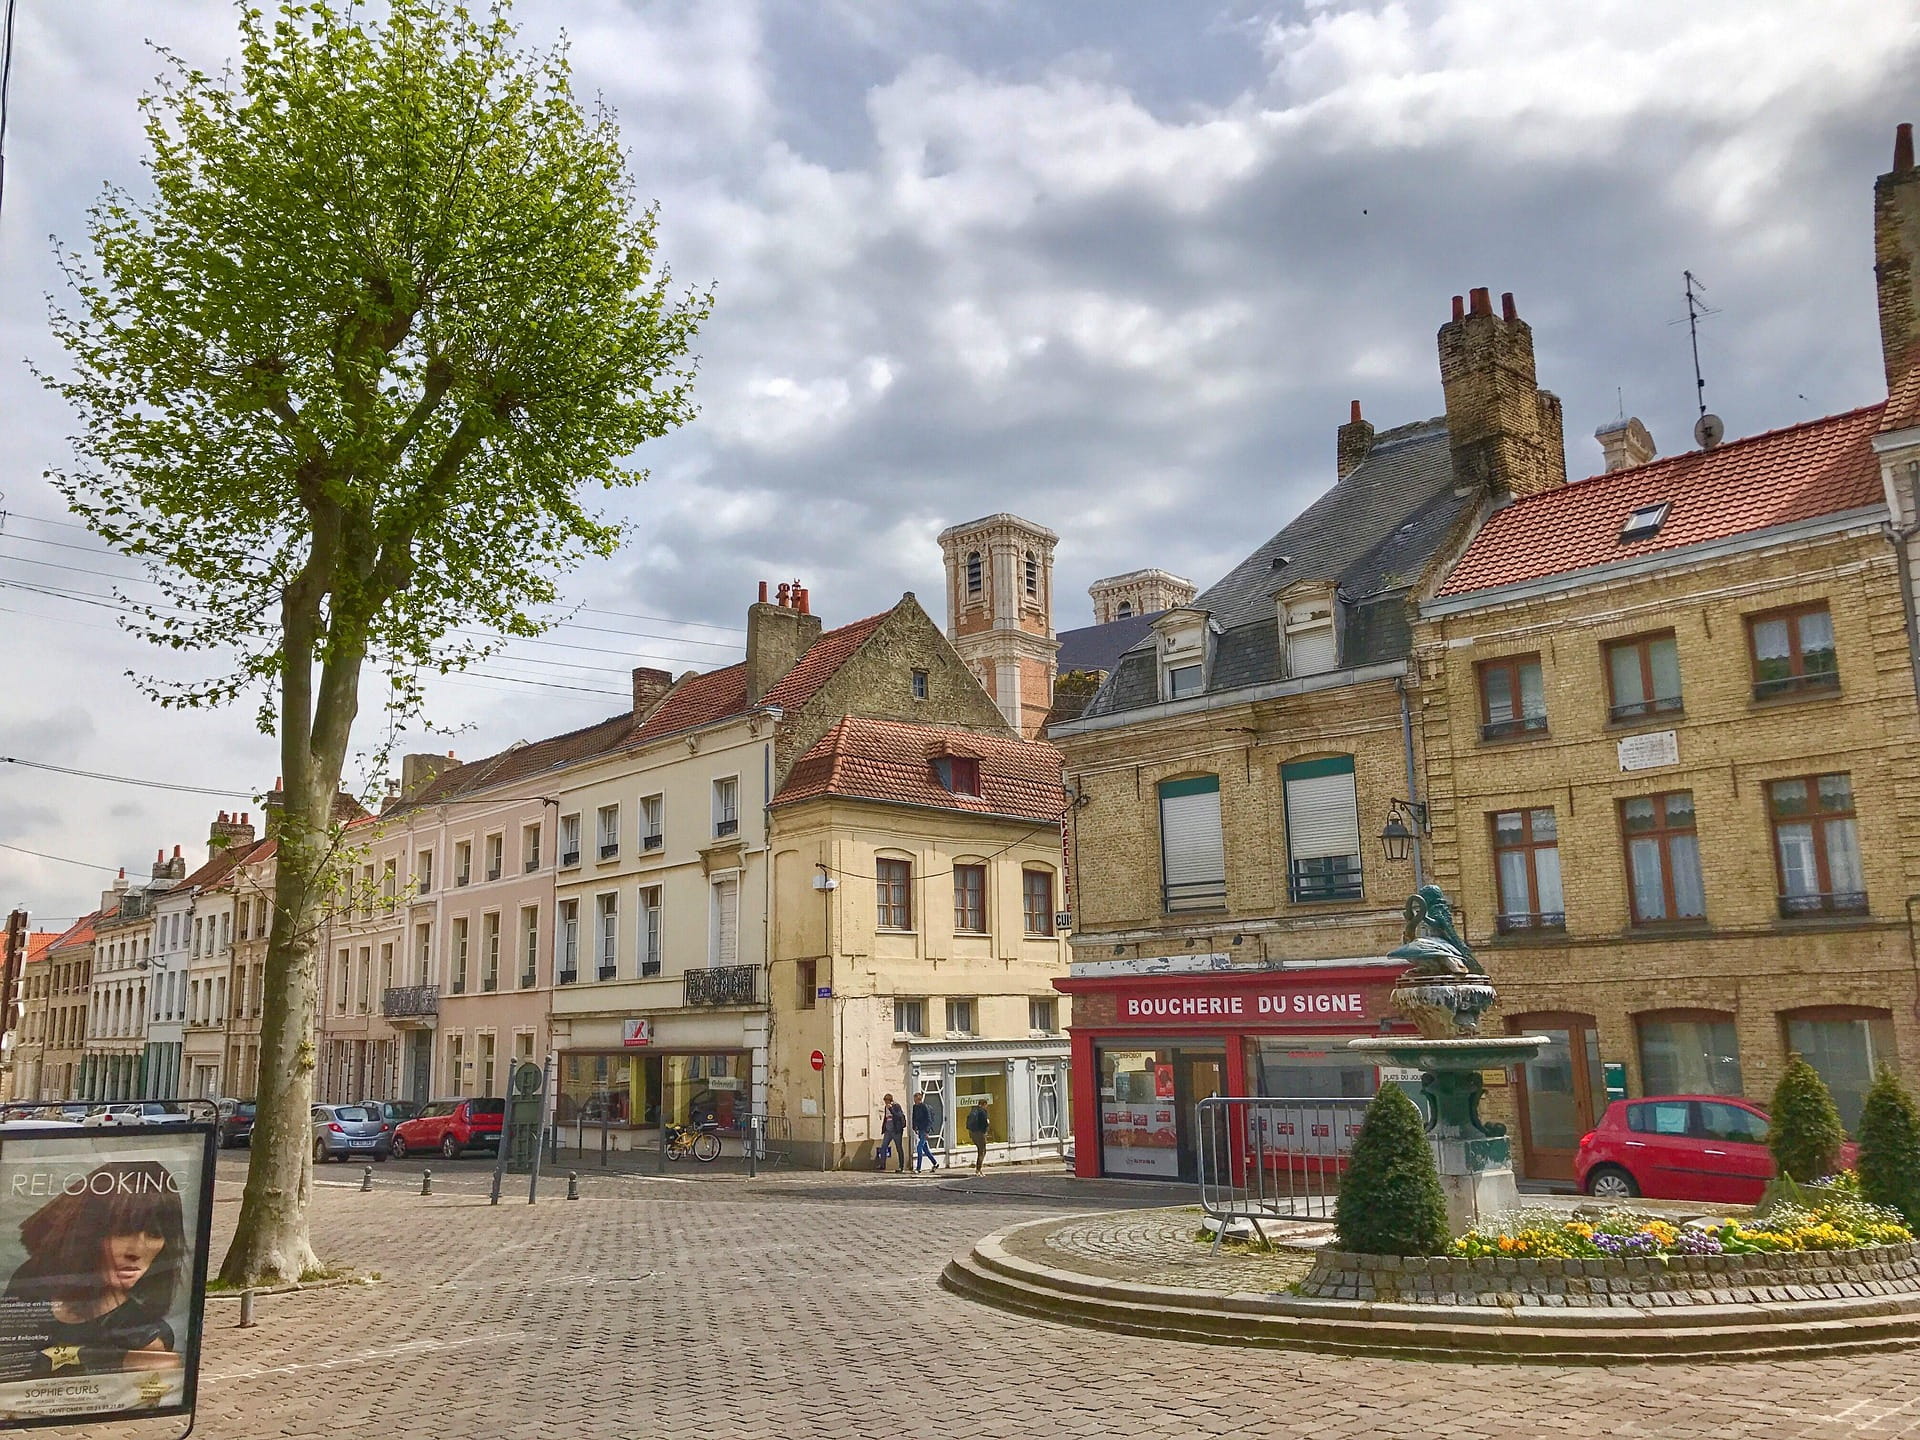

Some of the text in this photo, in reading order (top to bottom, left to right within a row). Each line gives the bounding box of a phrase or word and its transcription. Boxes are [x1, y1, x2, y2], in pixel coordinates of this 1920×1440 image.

[1128, 994, 1362, 1015] BOUCHERIE DU SIGNE
[11, 1171, 190, 1196] RELOOKING
[25, 1384, 99, 1398] SOPHIE CURLS
